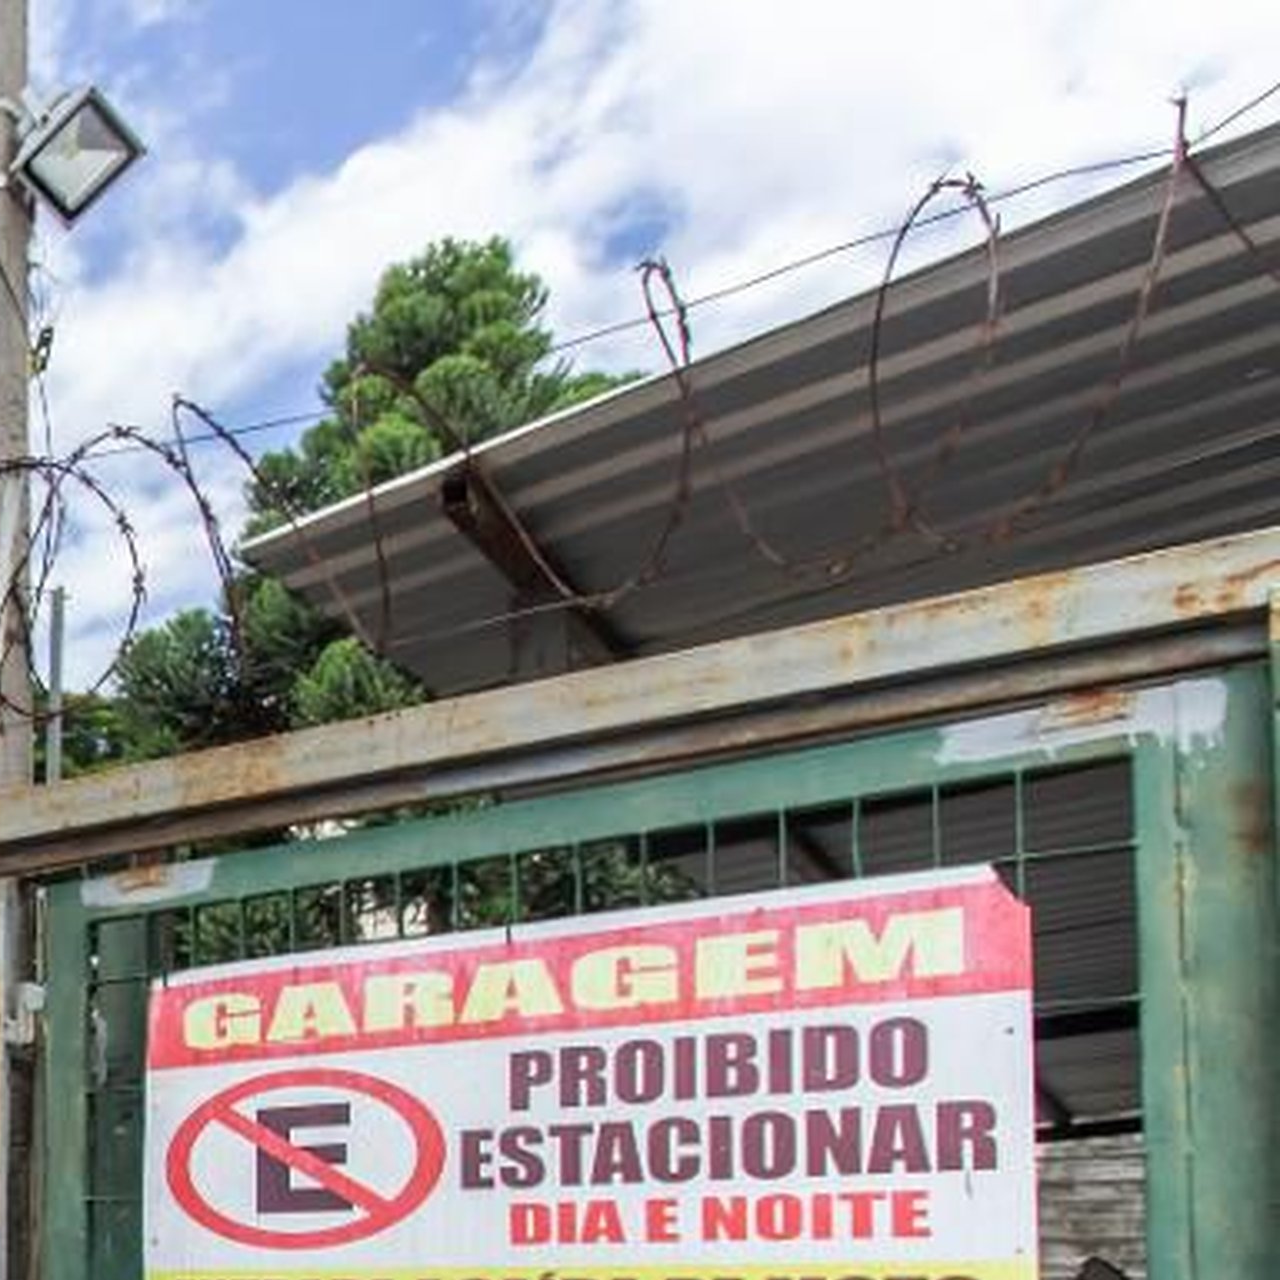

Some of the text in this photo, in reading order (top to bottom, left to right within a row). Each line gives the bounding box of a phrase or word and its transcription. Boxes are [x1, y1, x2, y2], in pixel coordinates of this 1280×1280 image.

[183, 908, 964, 1050] GARAGEM
[509, 1016, 929, 1111] PROIBIDO
[256, 1102, 353, 1214] E
[460, 1100, 998, 1190] ESTACIONAR
[509, 1190, 932, 1246] DIA E NOITE
